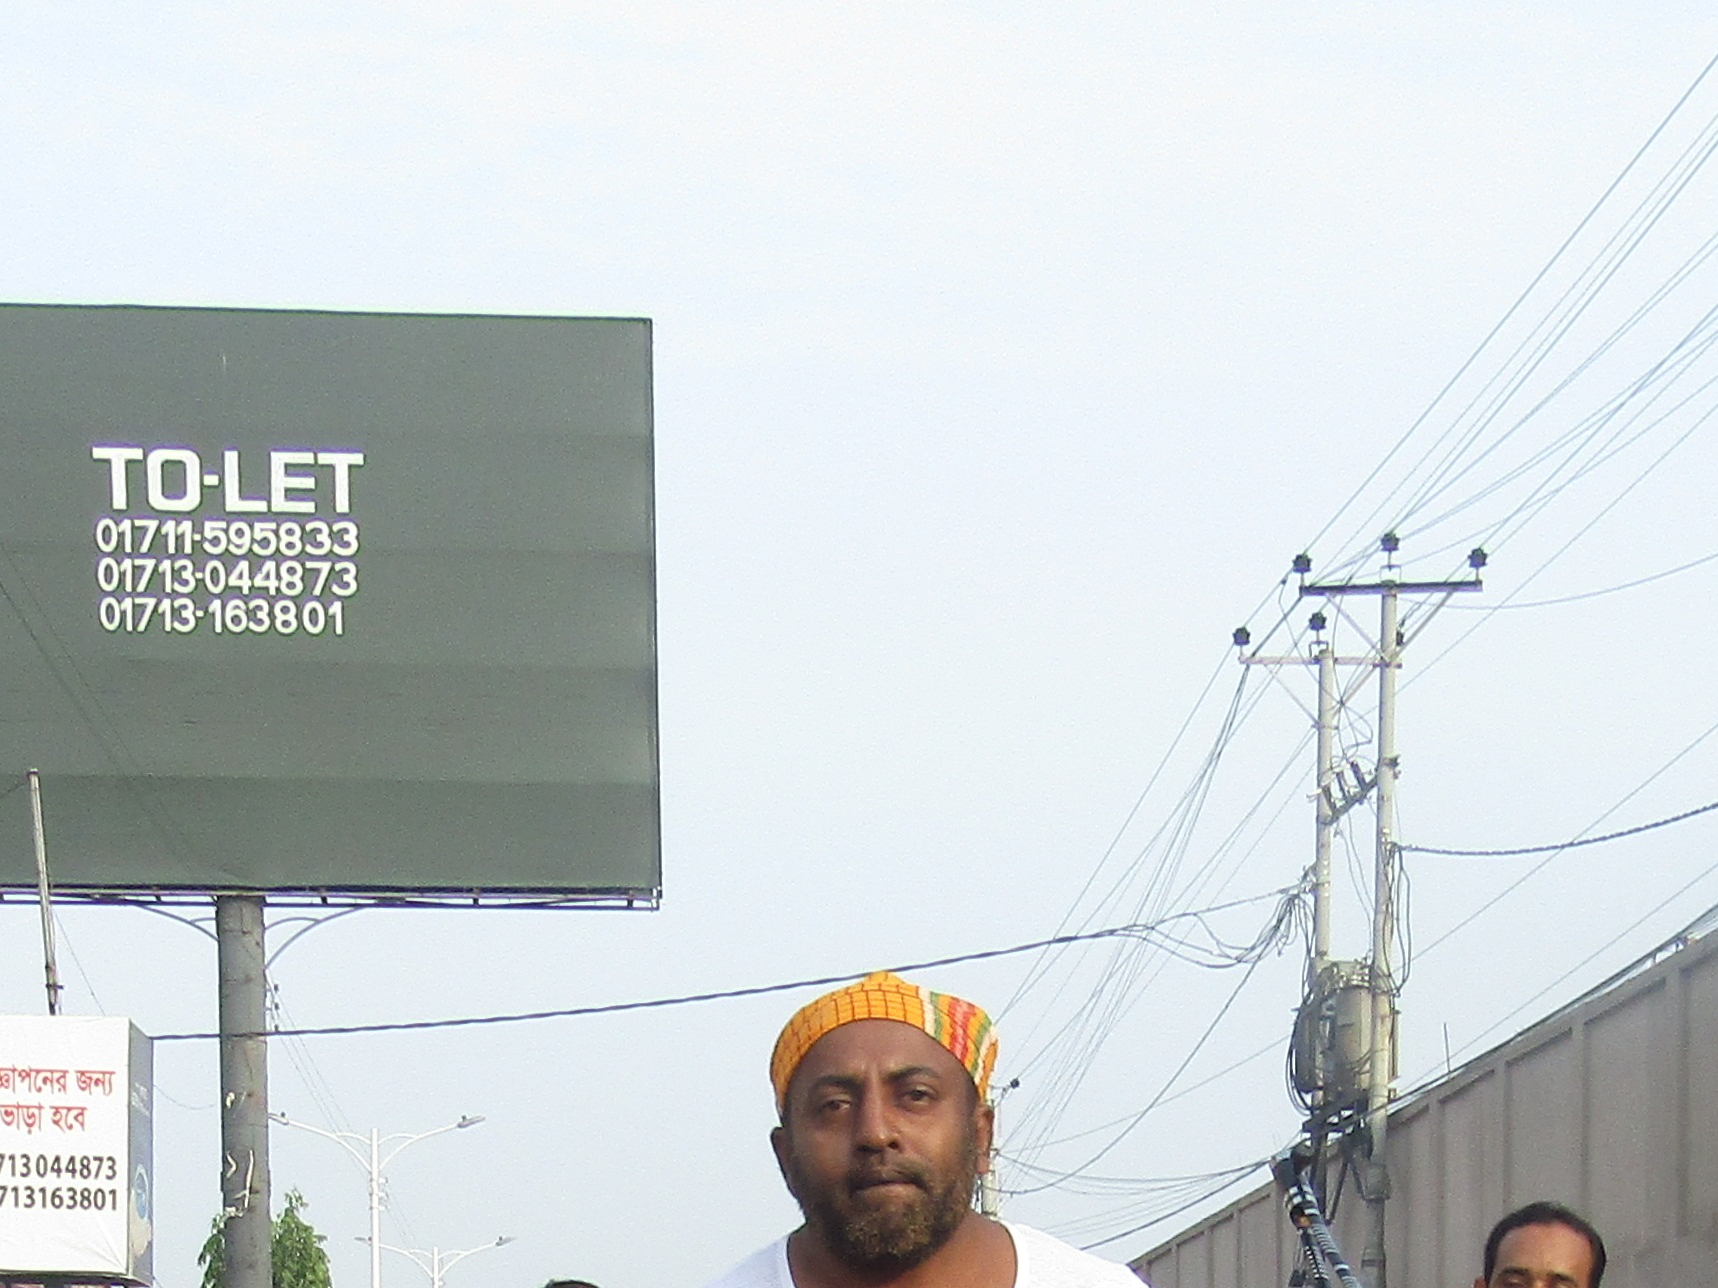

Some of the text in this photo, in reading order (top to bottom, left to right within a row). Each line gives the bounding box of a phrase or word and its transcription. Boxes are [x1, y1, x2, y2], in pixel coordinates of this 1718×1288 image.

[91, 446, 365, 513] TO-LET
[95, 517, 360, 556] 01711-595833
[97, 557, 358, 597] 01713-044873
[99, 597, 344, 635] 01713-163801
[74, 1070, 116, 1096] জন্য
[49, 1106, 89, 1134] হবে
